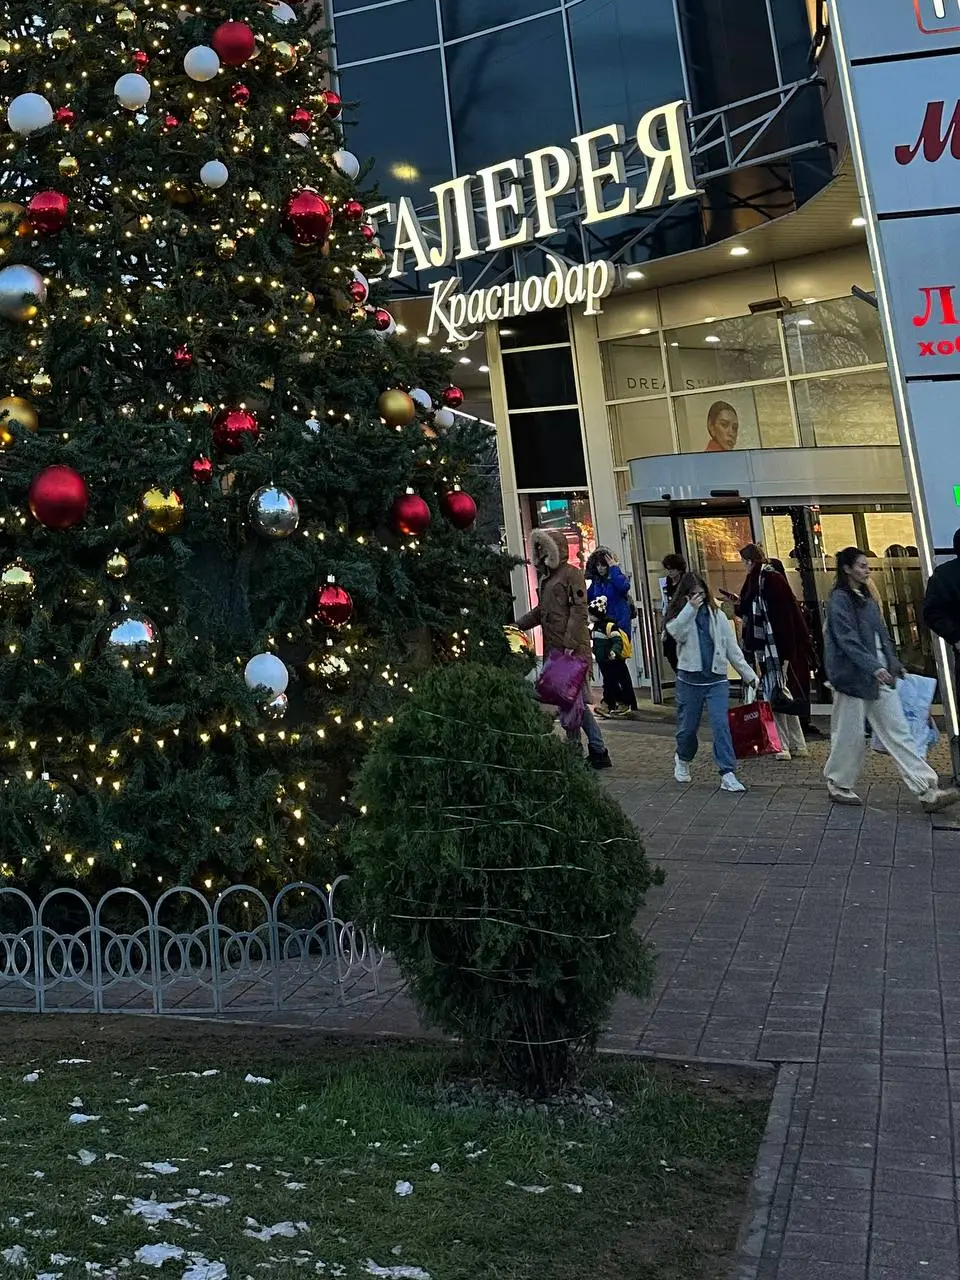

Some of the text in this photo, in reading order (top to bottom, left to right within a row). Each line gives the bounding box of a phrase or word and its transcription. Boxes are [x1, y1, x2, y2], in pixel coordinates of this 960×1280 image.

[364, 99, 704, 285] ГАЛЕРЕЯ
[427, 253, 617, 344] Краснодар
[627, 377, 696, 390] DRES
